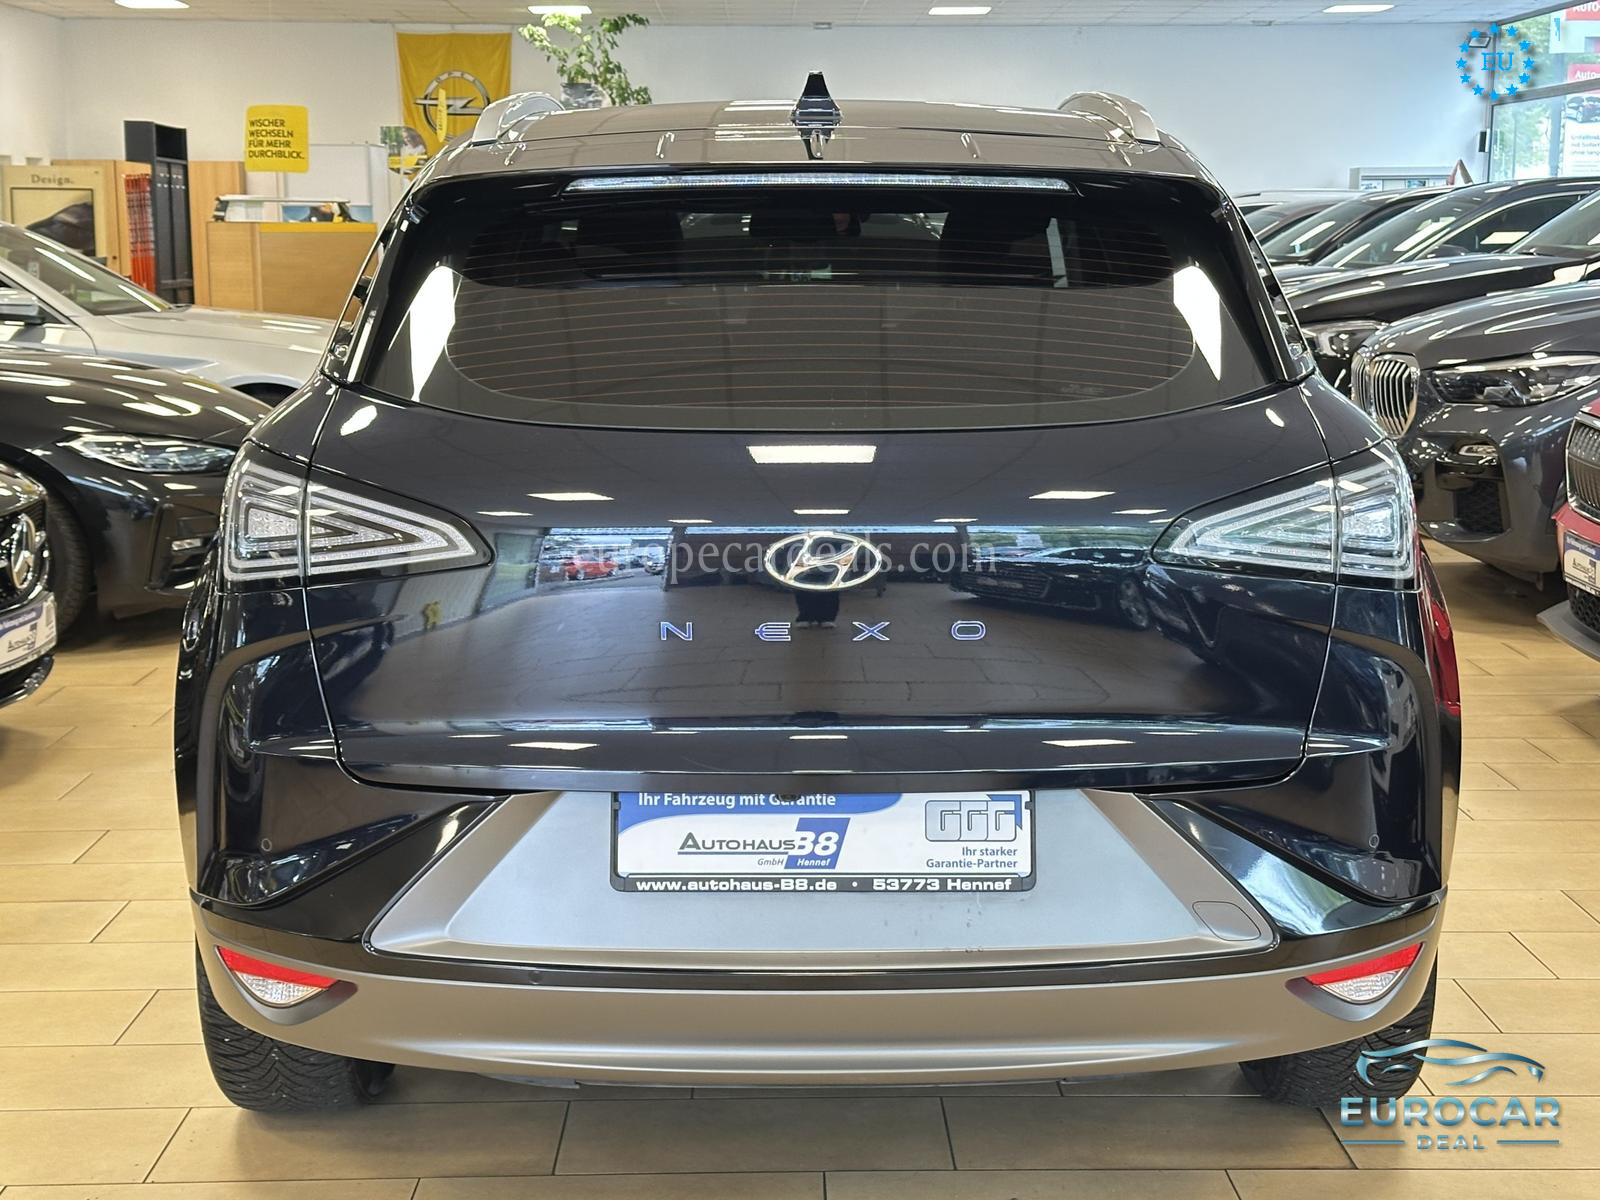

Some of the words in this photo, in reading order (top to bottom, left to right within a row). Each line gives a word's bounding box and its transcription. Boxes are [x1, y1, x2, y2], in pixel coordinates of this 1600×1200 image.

[248, 119, 286, 128] WISCHER
[248, 129, 294, 138] WECHSELN
[248, 138, 264, 148] FÜR
[266, 139, 291, 149] MEHR
[248, 150, 305, 160] DURCHBLICK.
[30, 174, 75, 186] Design.
[638, 792, 661, 806] Ihr
[664, 792, 736, 809] Fahrzeug
[740, 792, 766, 806] mit
[962, 847, 977, 856] Ihr
[980, 846, 1018, 857] starker
[757, 857, 785, 867] GmbH
[797, 857, 831, 867] Hennef
[926, 858, 1018, 868] Garantie-Partner
[636, 878, 838, 891] www.autohaus-B8.de
[873, 878, 940, 891] 53773
[947, 878, 1012, 891] Hennef
